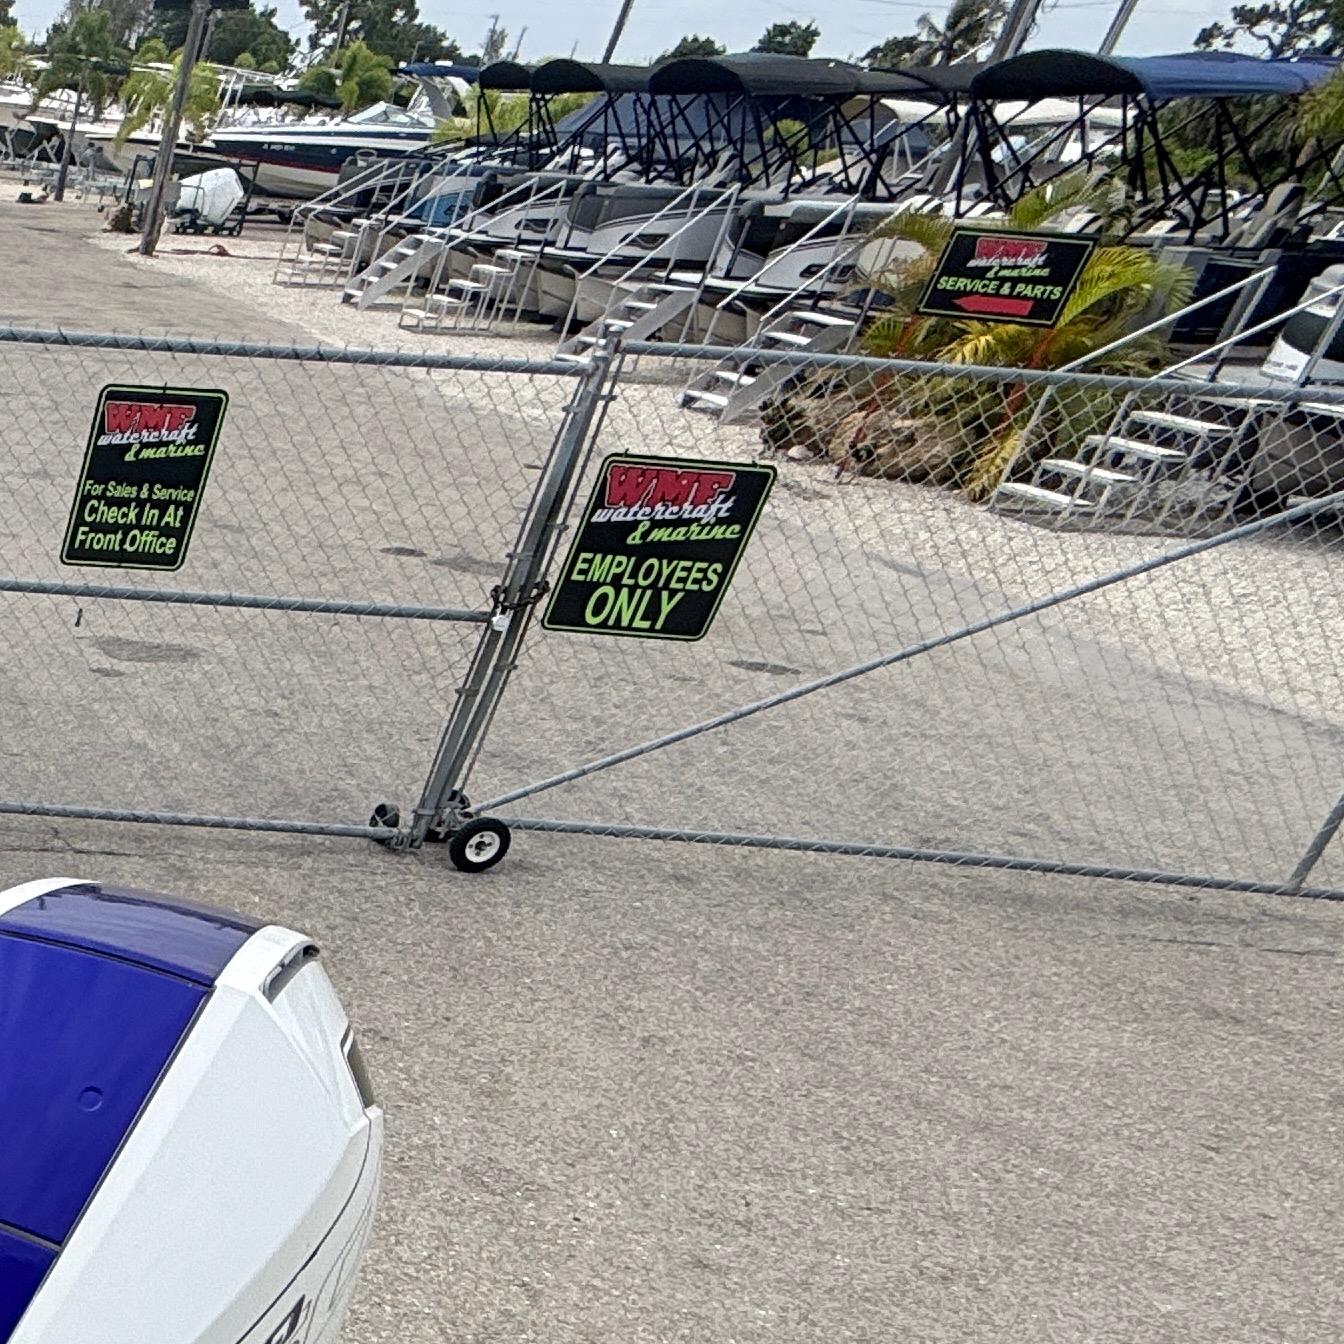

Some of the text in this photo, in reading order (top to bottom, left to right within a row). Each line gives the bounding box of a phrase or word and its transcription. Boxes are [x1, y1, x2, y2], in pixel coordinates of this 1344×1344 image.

[937, 276, 1063, 300] SERVICE & PARTS
[105, 401, 196, 434] WMF
[97, 423, 199, 446] watercraft
[124, 440, 206, 462] & marine
[84, 480, 195, 502] For Sales & Service
[605, 464, 736, 508] WMF
[84, 499, 184, 528] Check In At
[591, 492, 736, 523] watercraft
[75, 526, 178, 554] Front Office
[626, 518, 742, 545] & marine
[570, 552, 723, 593] EMPLOYEES
[584, 585, 686, 630] ONLY
